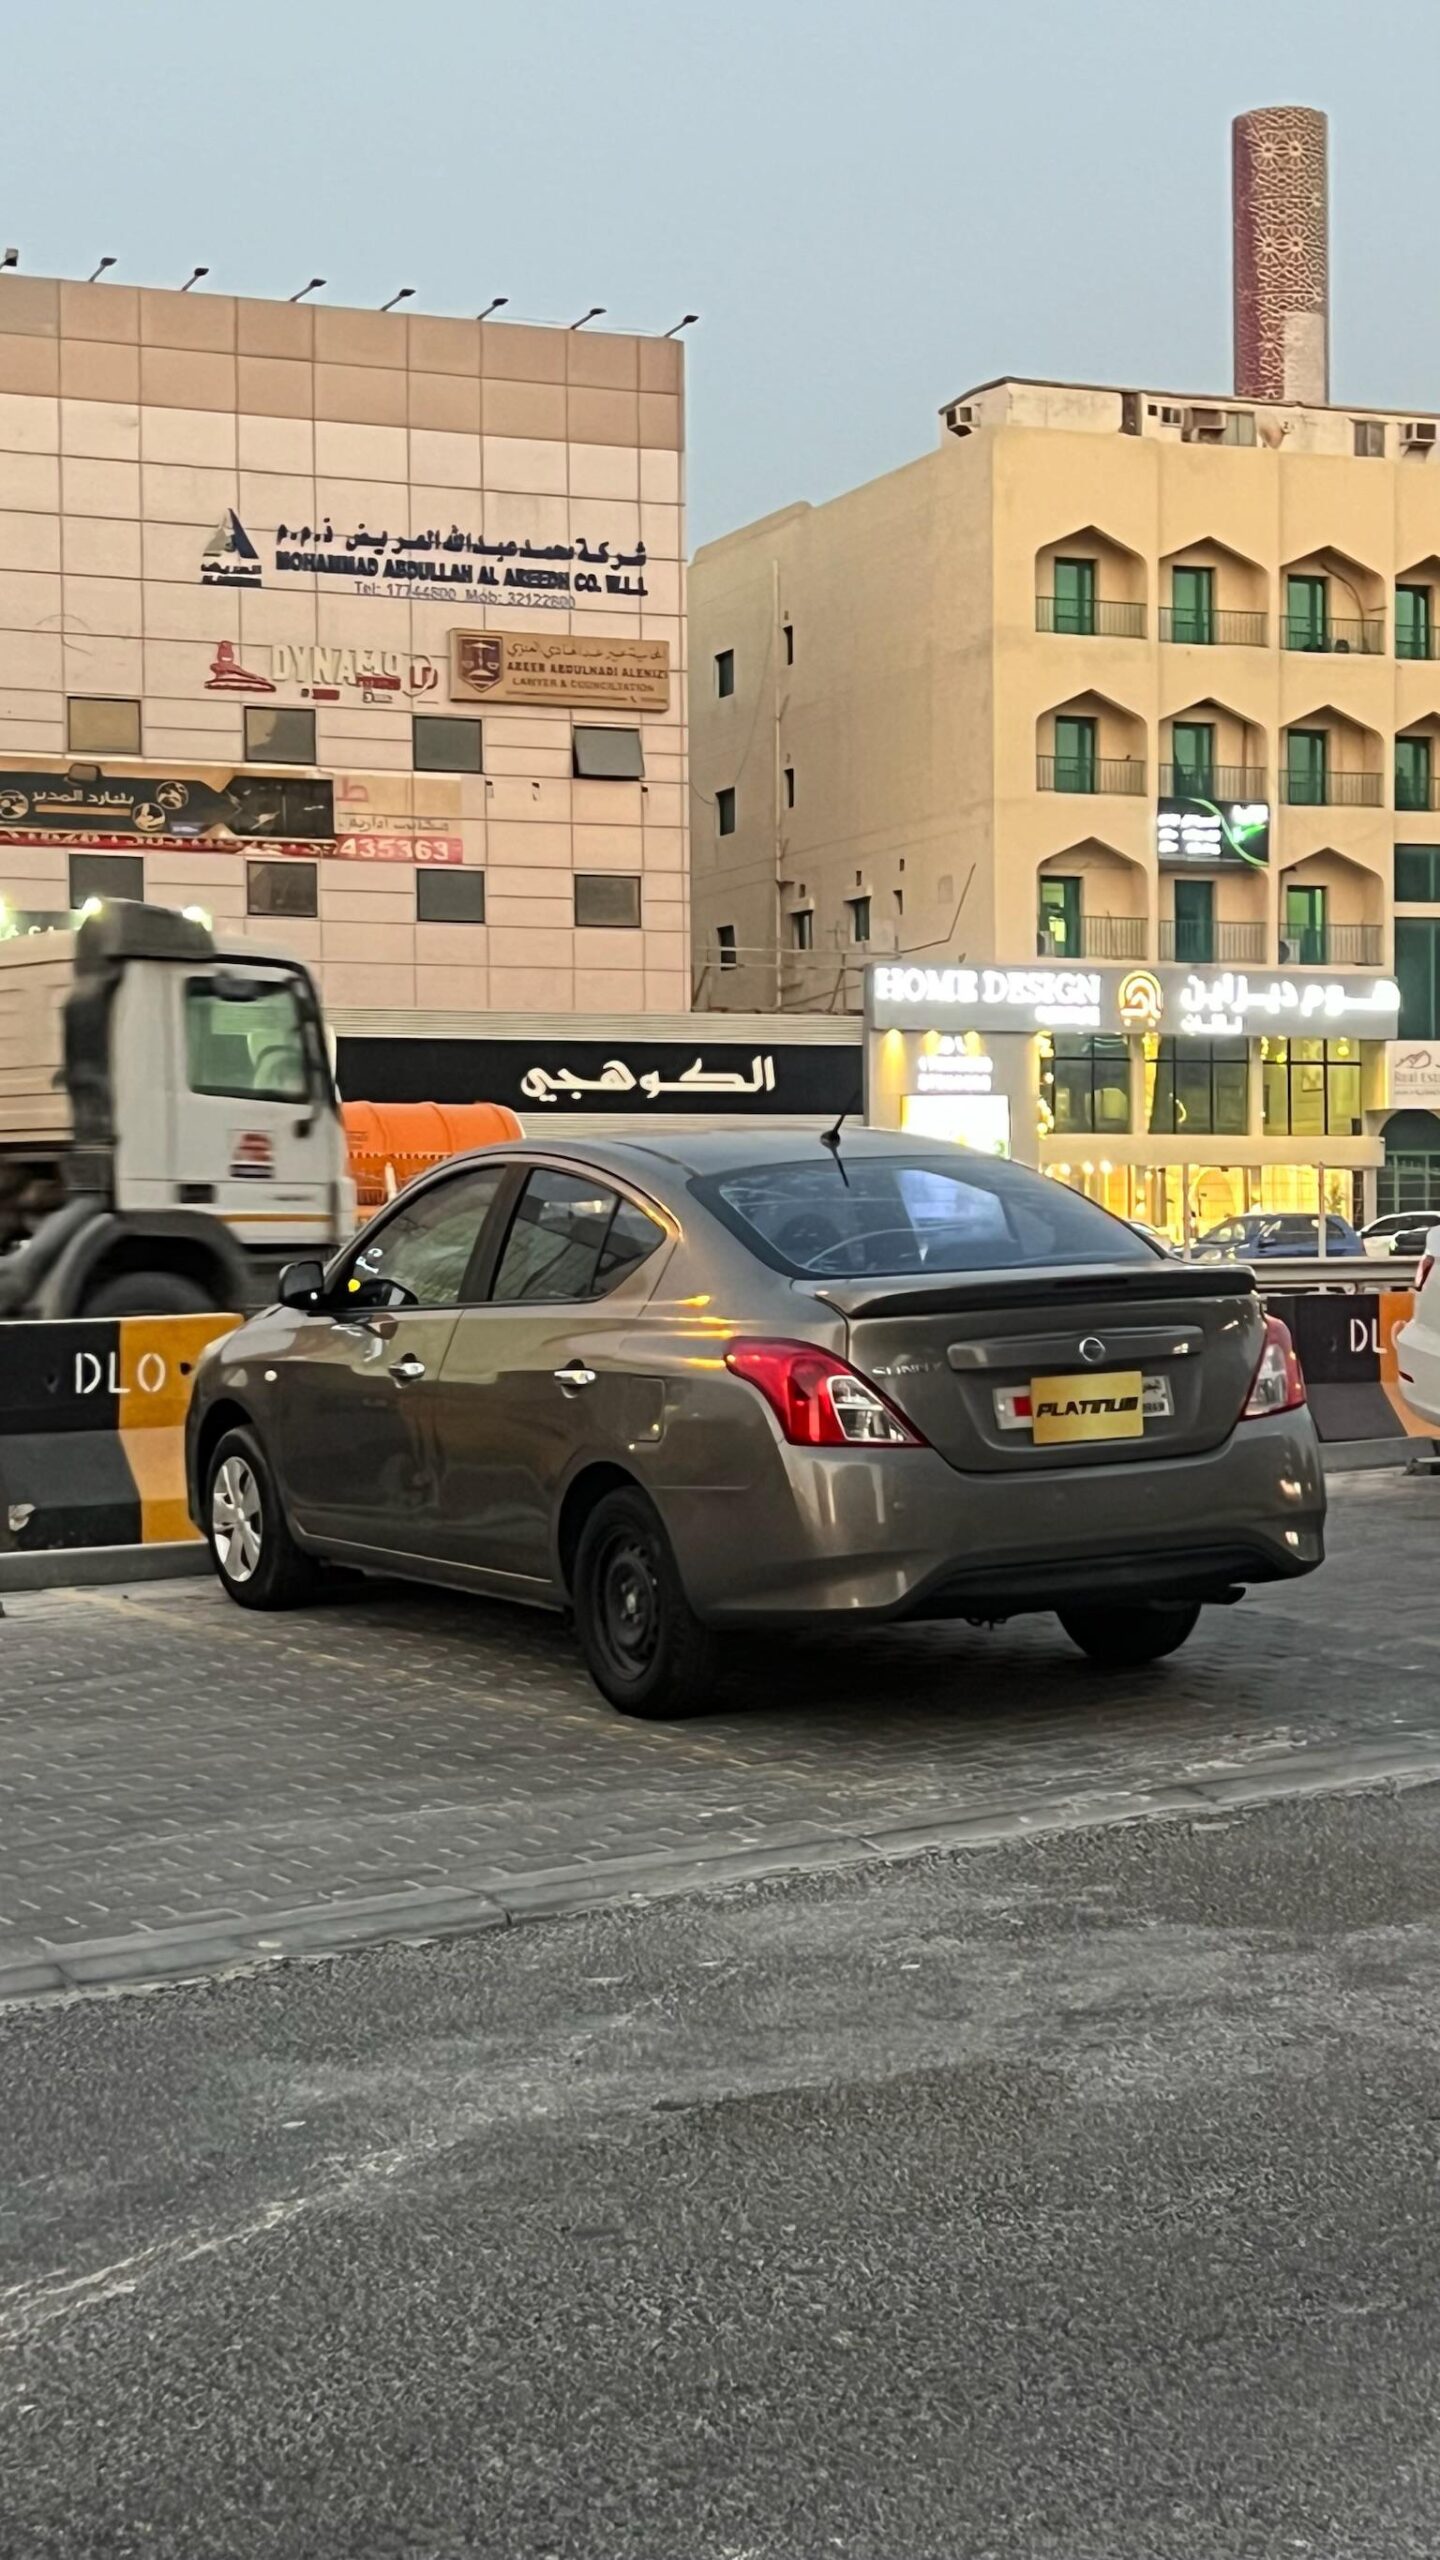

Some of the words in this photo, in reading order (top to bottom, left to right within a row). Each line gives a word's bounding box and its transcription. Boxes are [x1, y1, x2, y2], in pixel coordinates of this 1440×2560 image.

[275, 550, 379, 577] MOHAMMAD
[382, 558, 473, 584] ABDULLAH
[477, 565, 500, 586] AL
[874, 967, 979, 1002] HOME
[983, 970, 1101, 1005] DESIGN
[520, 1055, 776, 1102] الكوهجي
